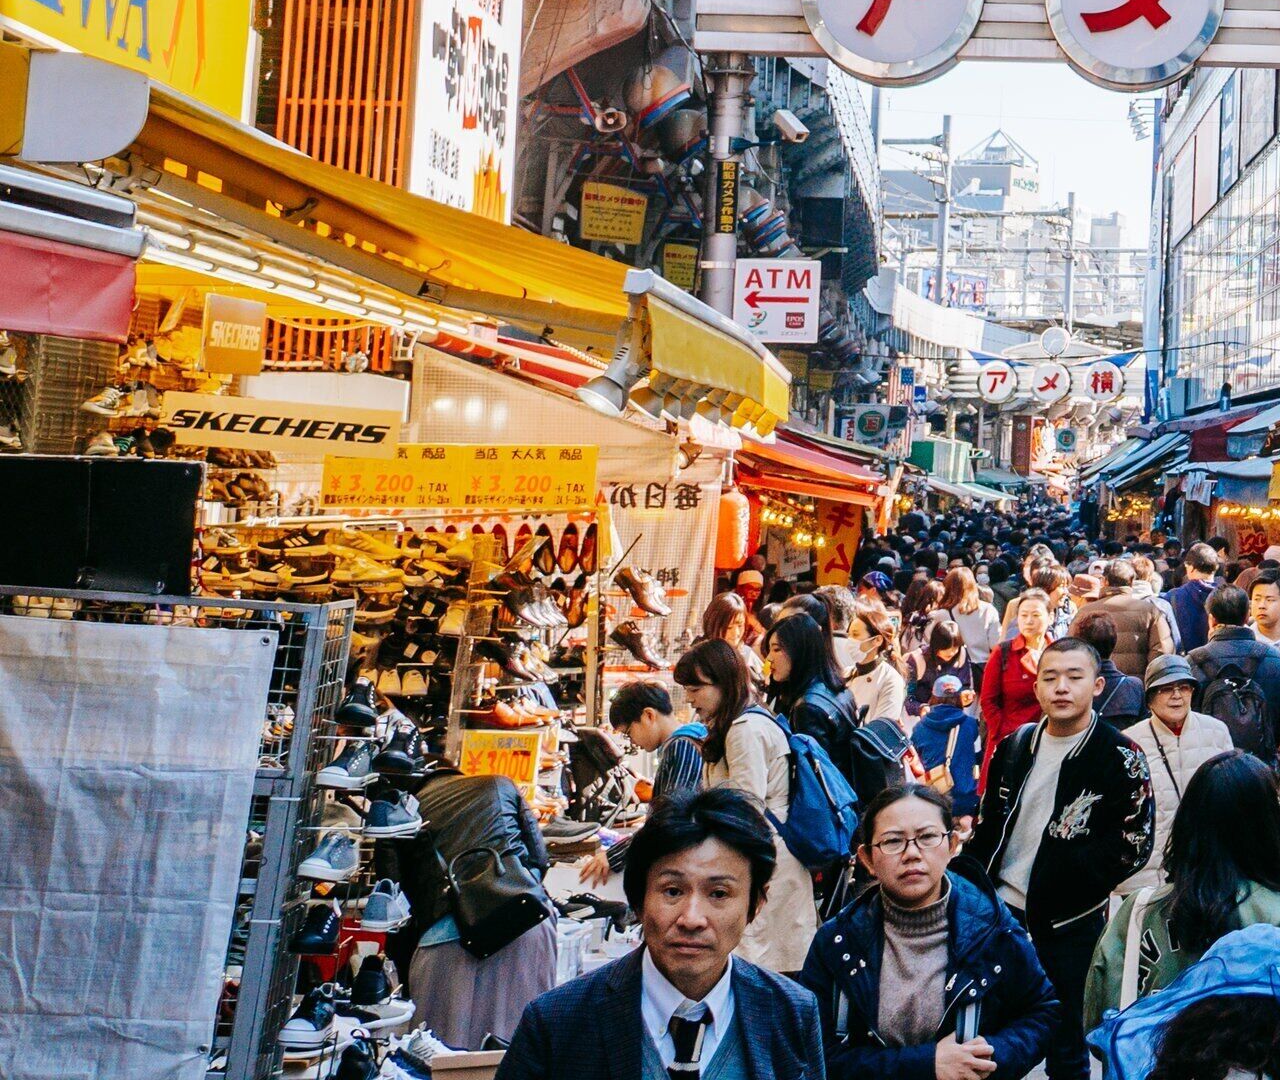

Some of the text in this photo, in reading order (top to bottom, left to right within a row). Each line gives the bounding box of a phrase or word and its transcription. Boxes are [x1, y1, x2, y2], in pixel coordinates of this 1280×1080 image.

[744, 269, 812, 290] ATM
[209, 320, 262, 351] SKECHERS
[987, 371, 1114, 394] アメ横
[167, 409, 391, 444] SKECHERS
[475, 448, 499, 460] 当店
[512, 448, 546, 460] 大人気
[429, 483, 448, 493] TAX
[566, 483, 585, 493] TAX
